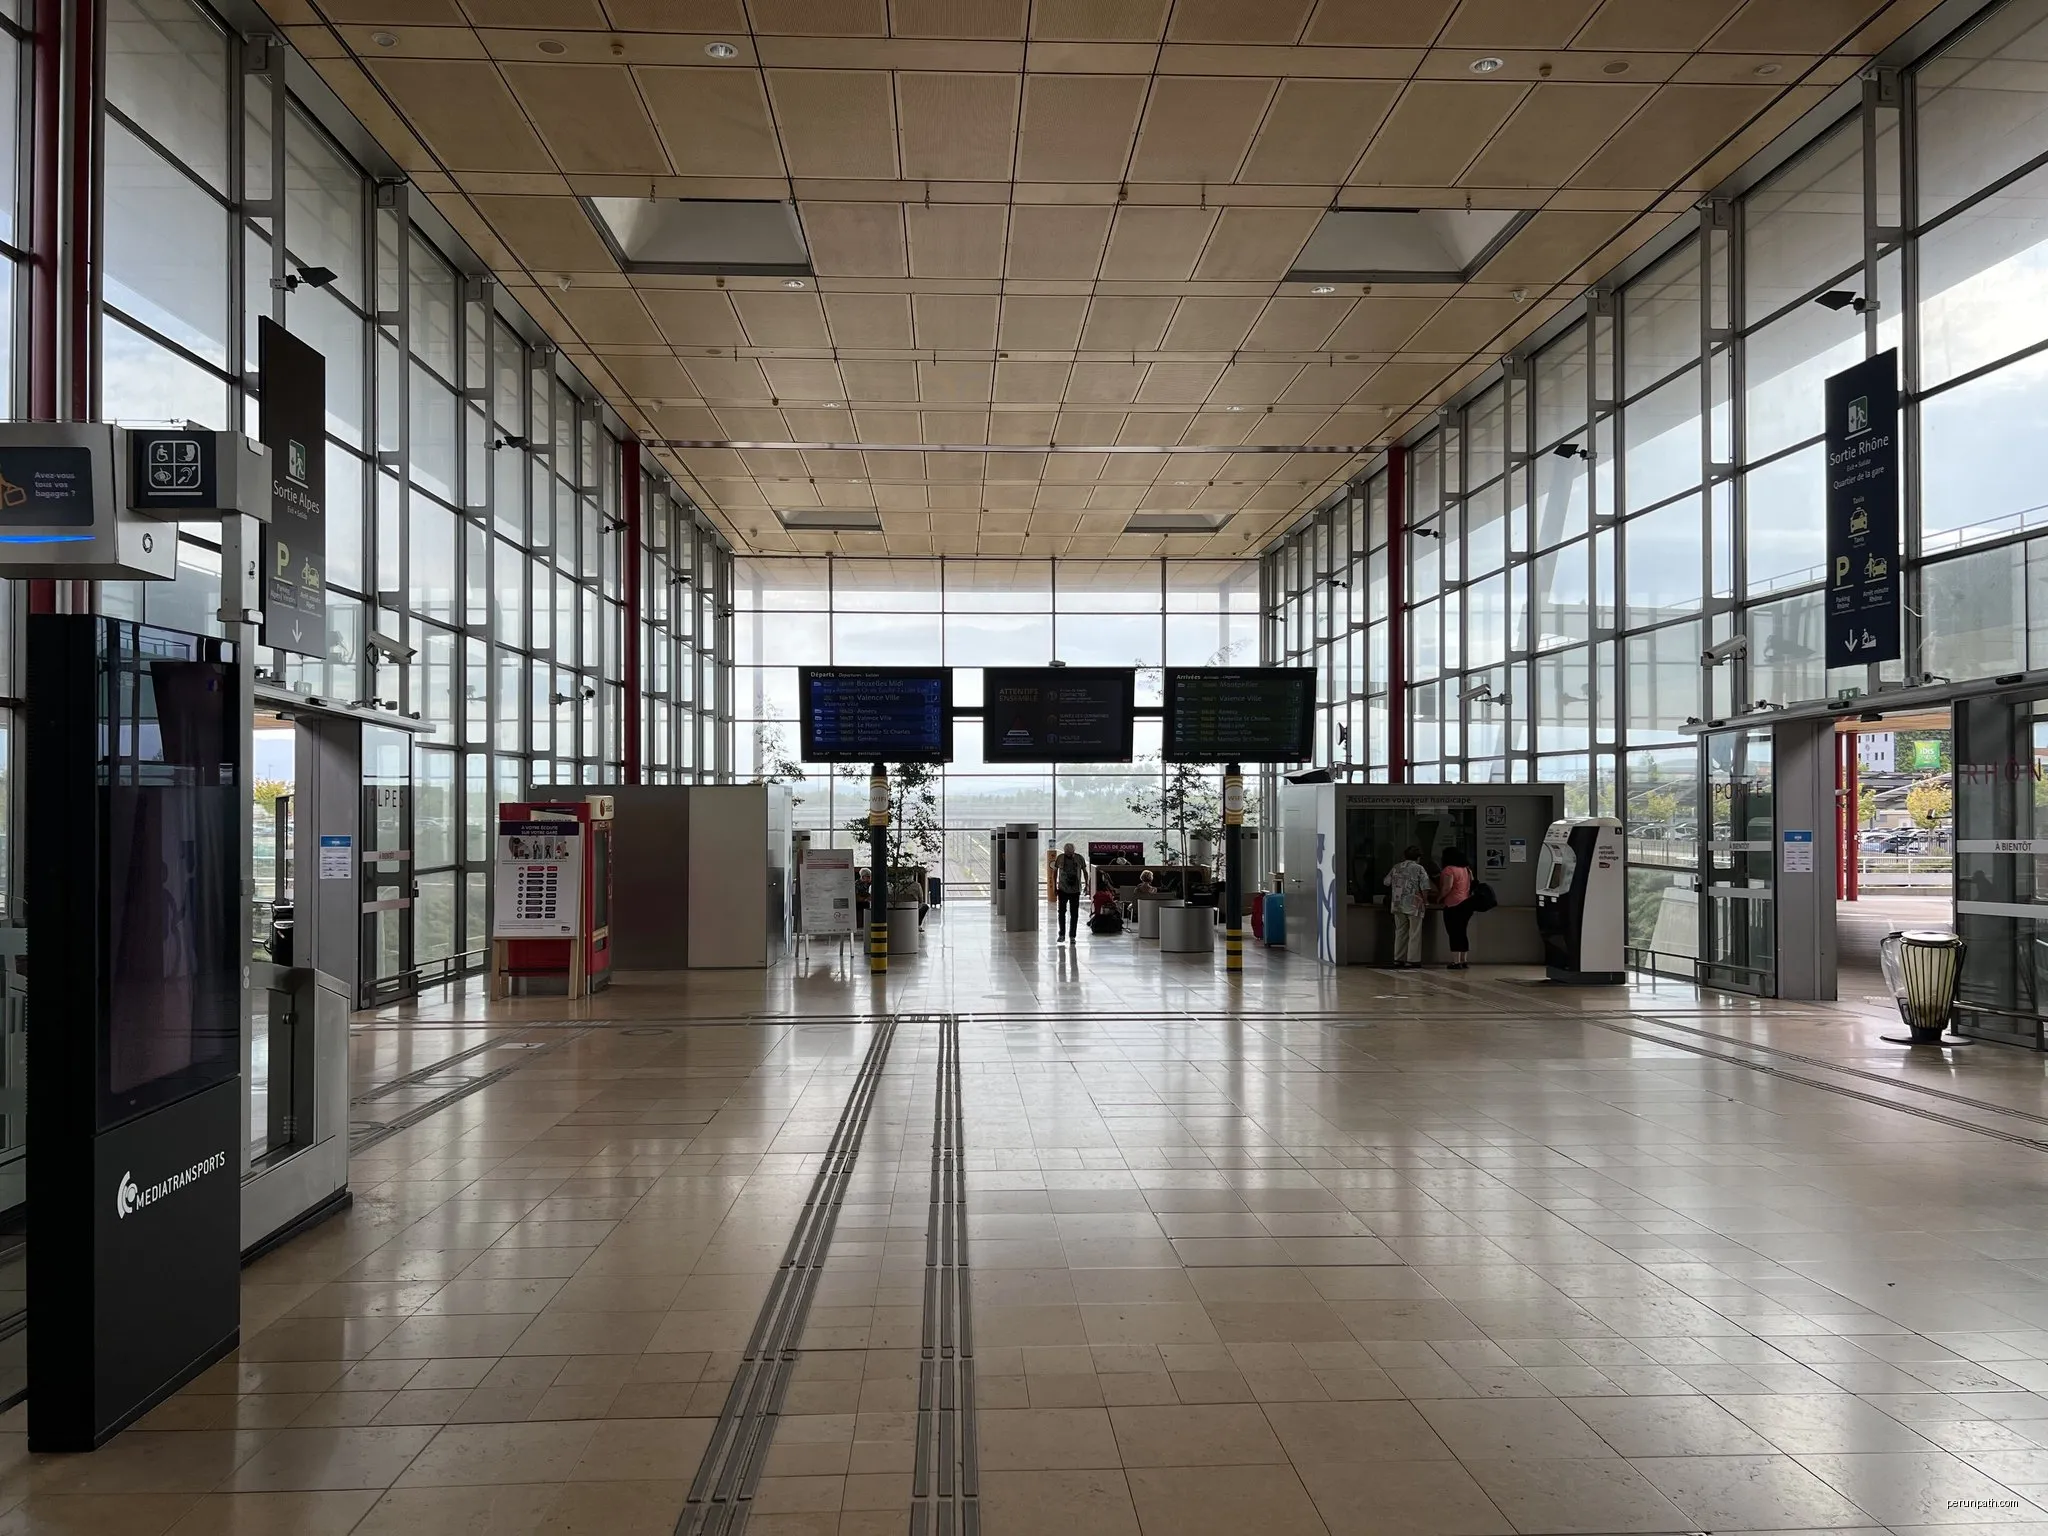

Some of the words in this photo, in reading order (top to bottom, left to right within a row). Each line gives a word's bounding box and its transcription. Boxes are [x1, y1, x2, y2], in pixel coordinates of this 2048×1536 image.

[1829, 446, 1857, 466] Sortie
[1858, 435, 1889, 456] Rhône
[34, 471, 76, 479] Avez-vous
[1833, 475, 1857, 490] Quartier
[1856, 472, 1865, 482] de
[1864, 470, 1871, 479] la
[1871, 466, 1885, 479] gare
[35, 489, 69, 499] bagages
[70, 489, 76, 497] ?
[273, 480, 298, 504] Sortie
[298, 491, 320, 514] Alpes
[277, 541, 290, 577] P
[1836, 555, 1850, 586] P
[810, 671, 835, 679] Départs
[1920, 747, 1935, 756] ibis
[369, 787, 404, 808] ALPES
[1347, 795, 1389, 804] Assistance
[1392, 797, 1428, 806] voyageur
[1715, 780, 1764, 801] PORTE
[2001, 841, 2032, 851] BIENTÔT
[135, 1150, 226, 1211] MEDIATRANSPORTS
